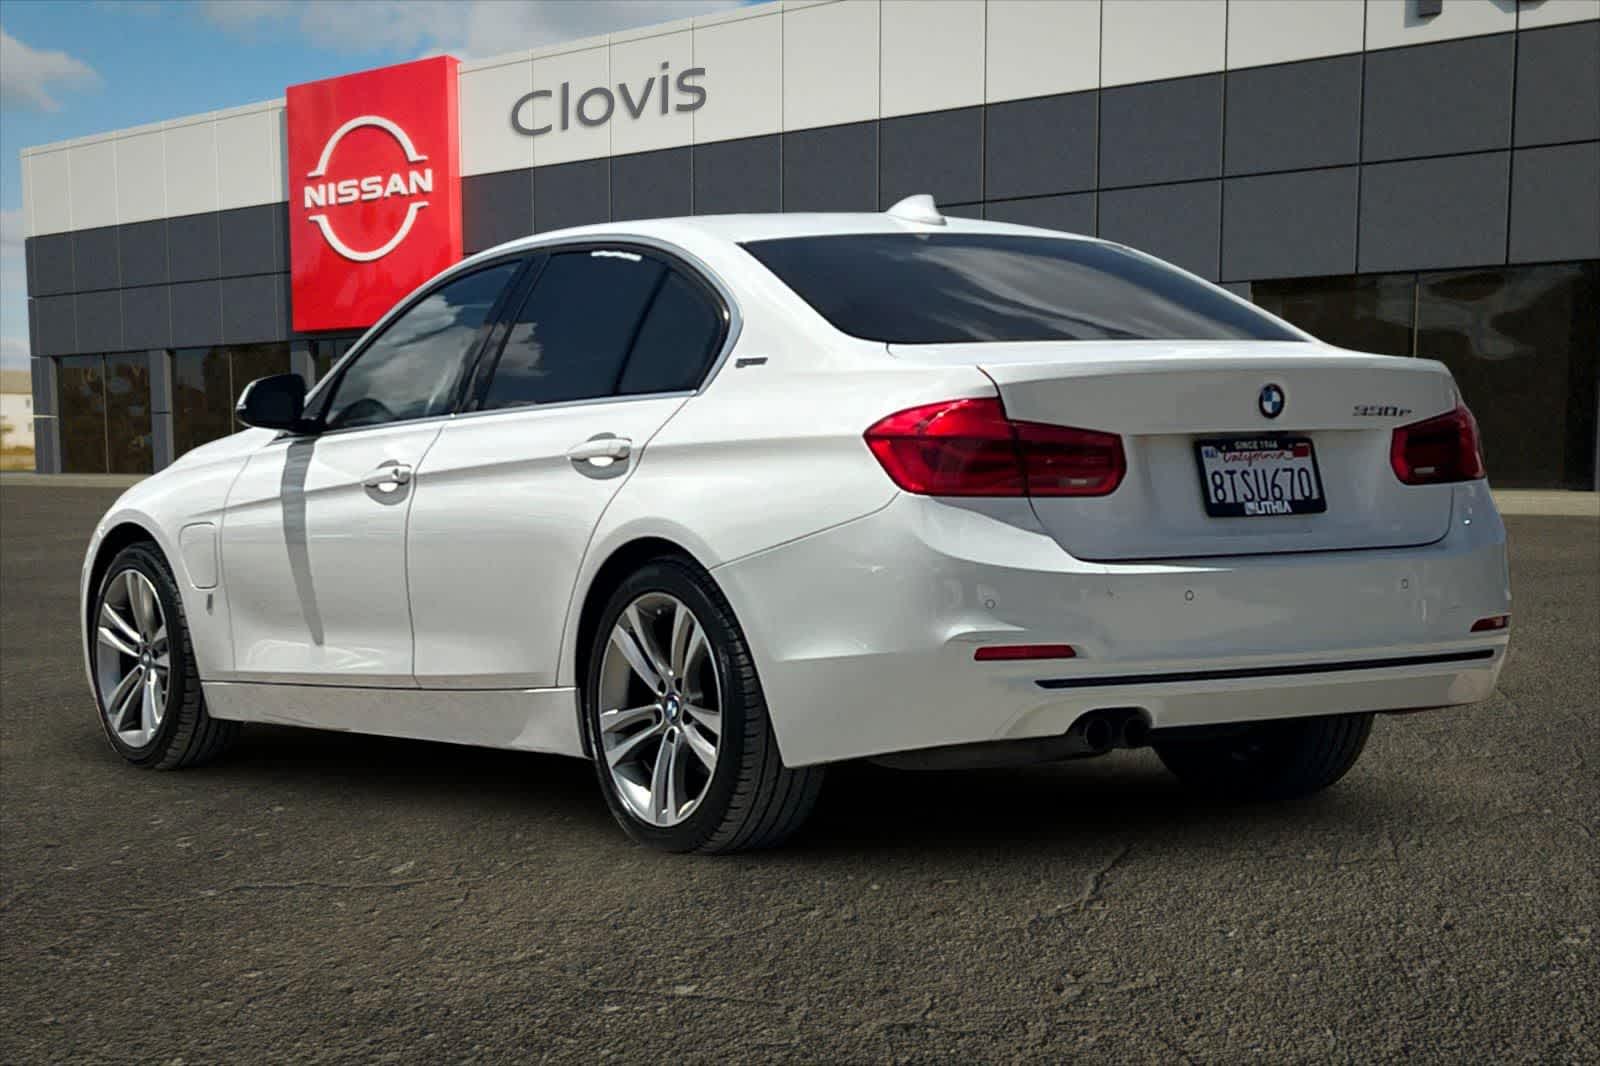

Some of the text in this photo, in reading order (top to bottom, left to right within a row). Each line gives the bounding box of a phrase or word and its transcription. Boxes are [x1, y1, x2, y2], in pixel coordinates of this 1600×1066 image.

[511, 61, 707, 136] Clovis
[303, 168, 433, 208] NISSAN
[1211, 467, 1313, 503] 8TSU670
